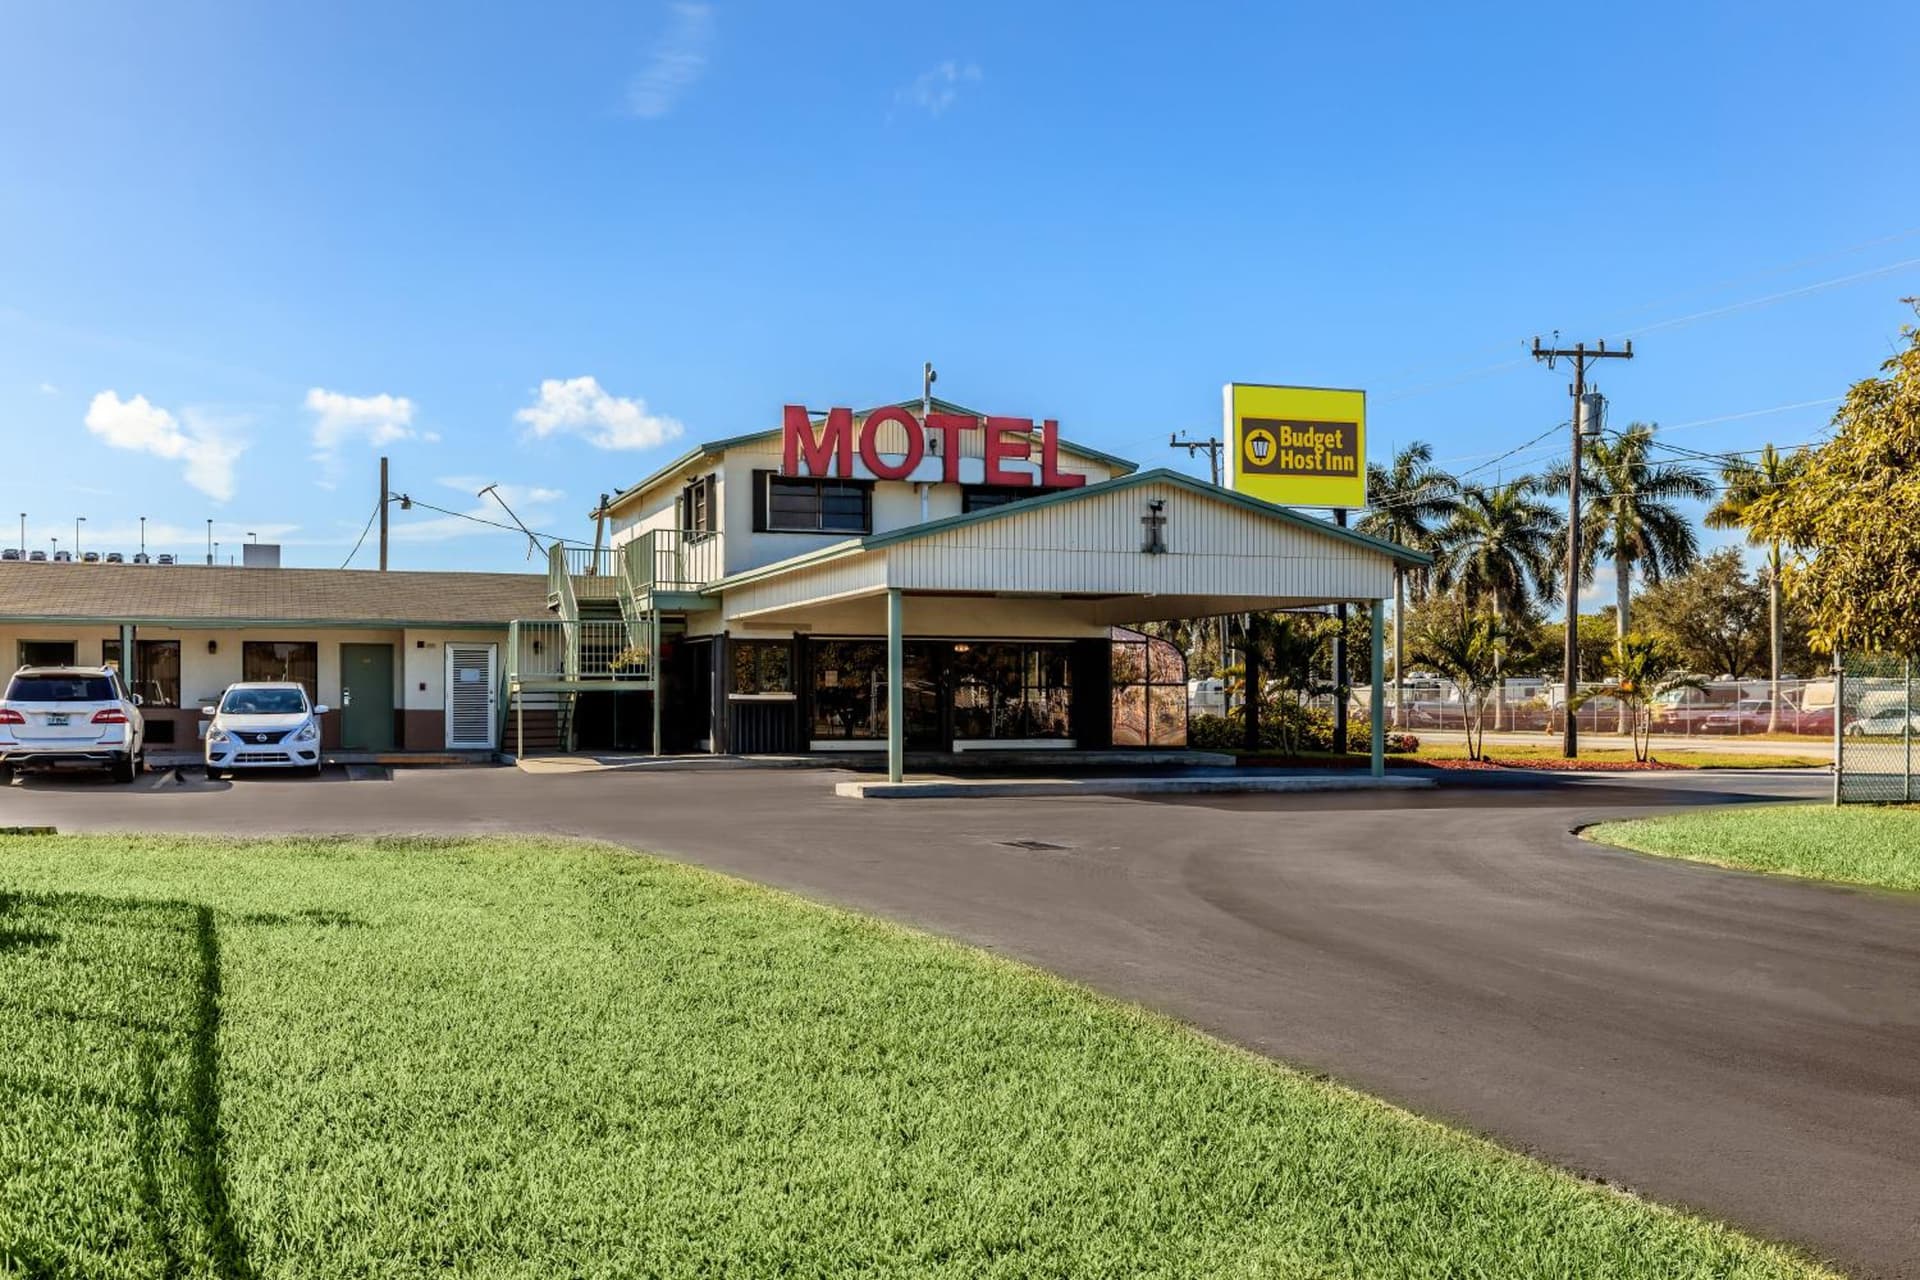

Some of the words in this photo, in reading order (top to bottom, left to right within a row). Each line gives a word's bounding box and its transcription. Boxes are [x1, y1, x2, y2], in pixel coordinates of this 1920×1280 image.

[783, 405, 1086, 487] MOTEL
[1280, 425, 1343, 454] Budget
[1280, 449, 1322, 470] Host
[1326, 451, 1354, 470] Inn
